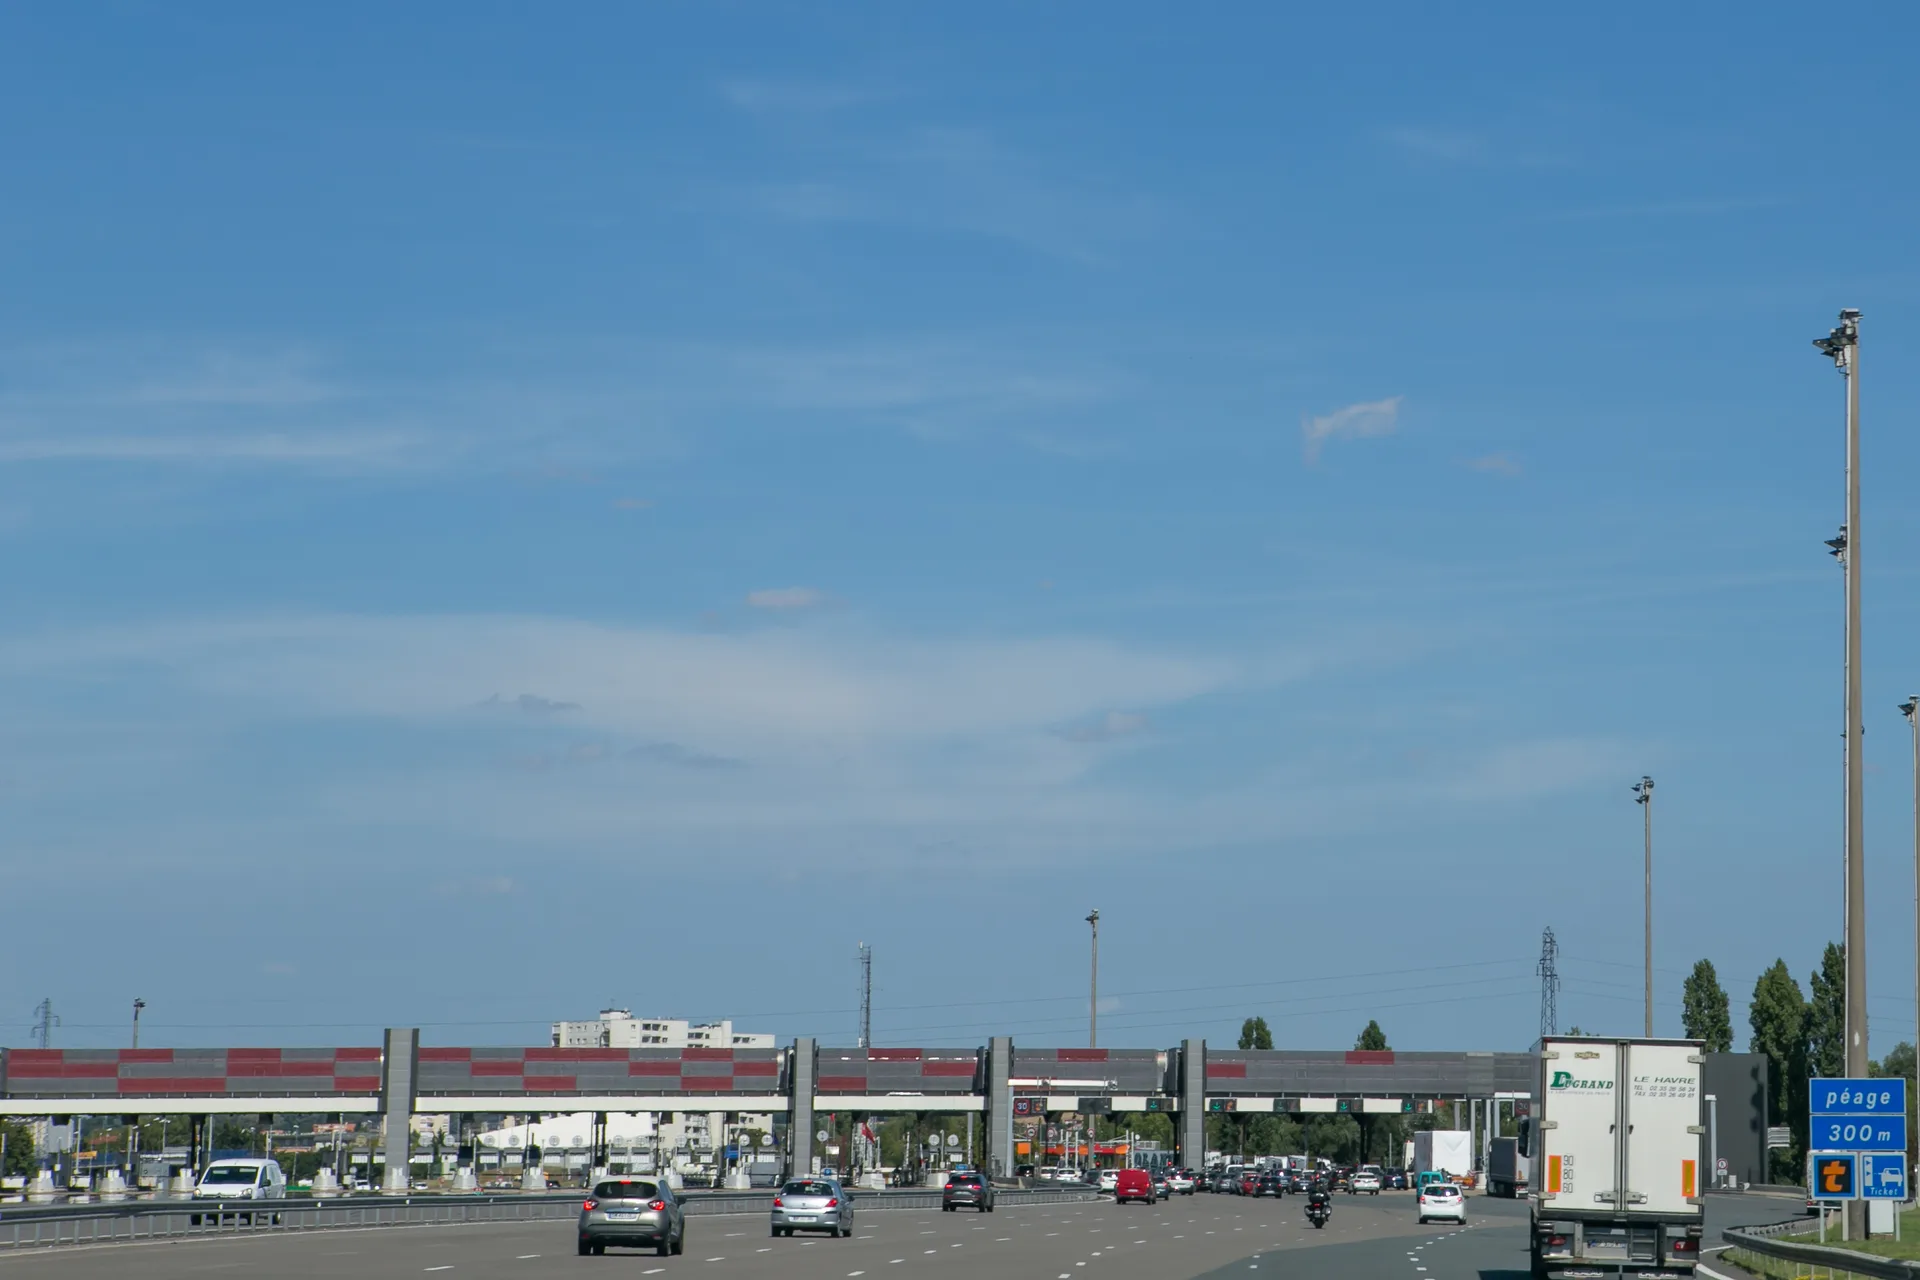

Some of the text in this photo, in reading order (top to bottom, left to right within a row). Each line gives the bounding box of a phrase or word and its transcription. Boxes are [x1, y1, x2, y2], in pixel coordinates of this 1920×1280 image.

[1550, 1071, 1614, 1090] DUGRAND
[1654, 1077, 1696, 1085] HAVRE
[1825, 1087, 1891, 1110] péage
[1017, 1102, 1028, 1110] 30
[1829, 1124, 1891, 1142] 300 m
[1563, 1154, 1574, 1166] 90
[1563, 1168, 1574, 1180] 80
[1562, 1182, 1573, 1194] 60
[1870, 1187, 1898, 1196] Ticket
